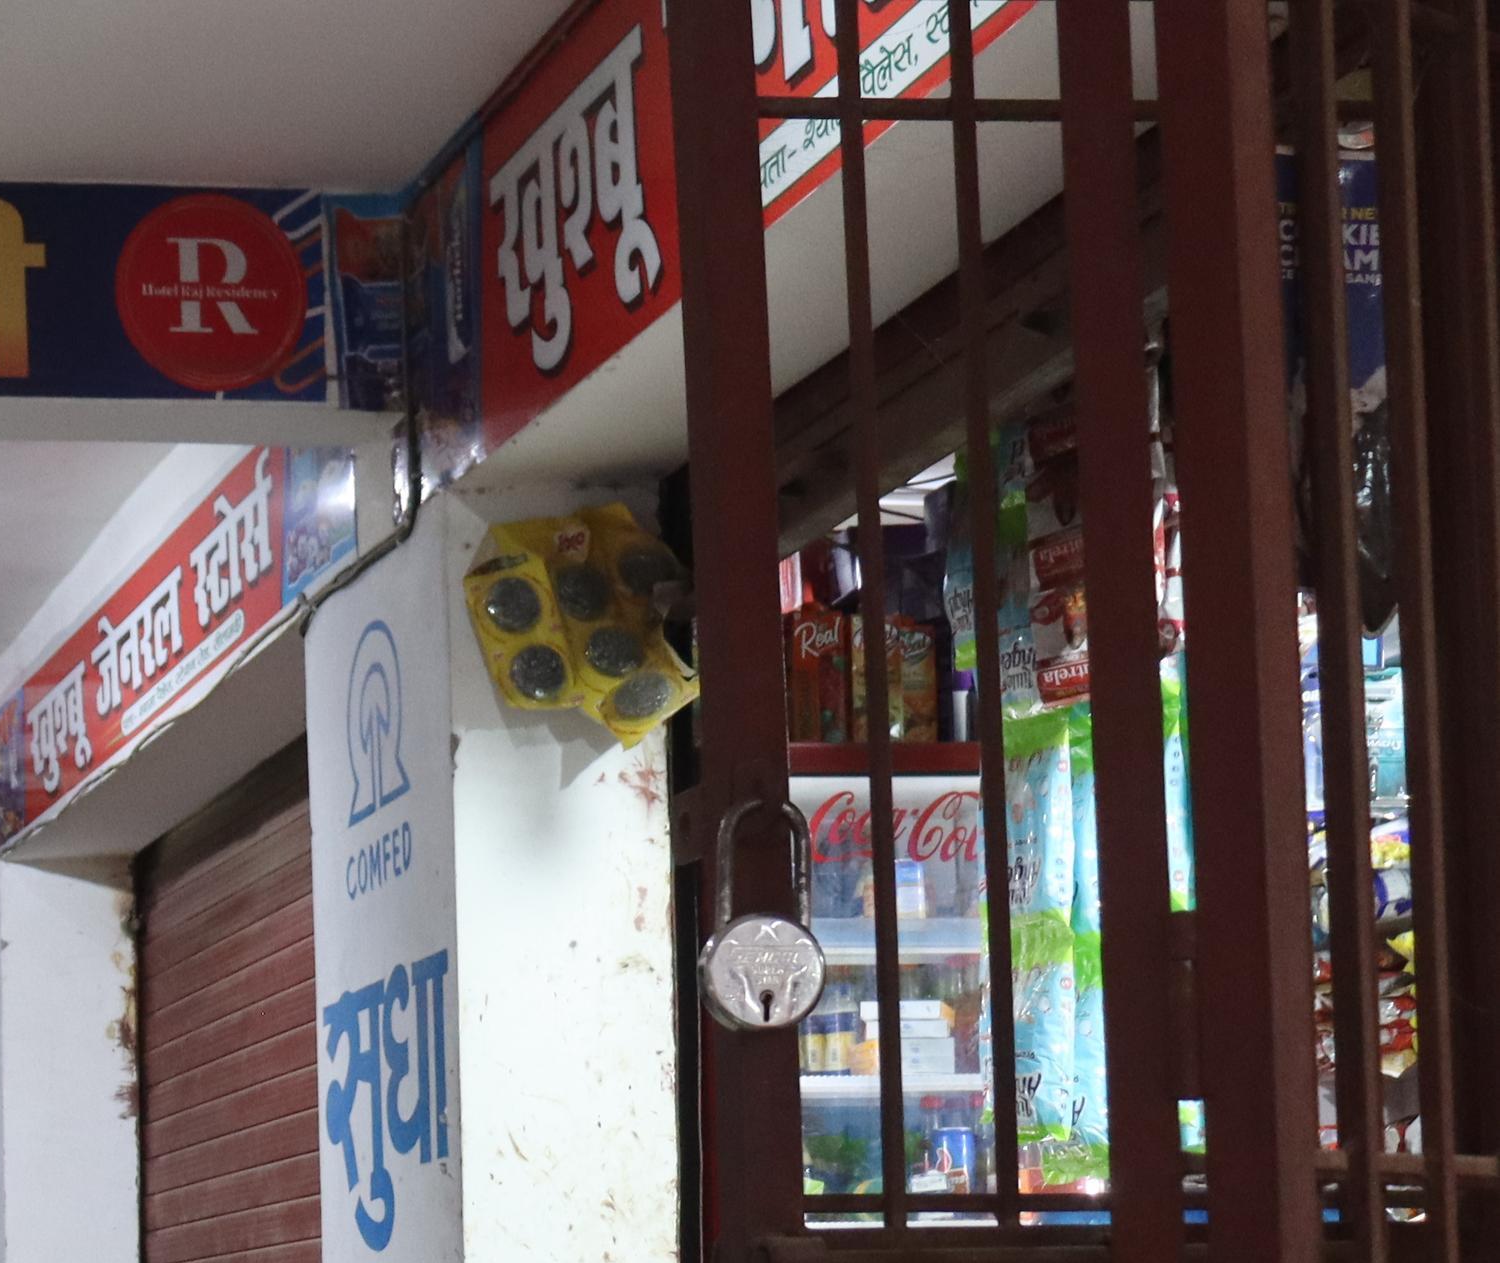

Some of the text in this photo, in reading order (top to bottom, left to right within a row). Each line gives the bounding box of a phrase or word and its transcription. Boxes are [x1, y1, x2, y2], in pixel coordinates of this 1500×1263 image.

[489, 24, 662, 372] खुशबू
[166, 237, 259, 335] R
[794, 617, 842, 659] Real
[26, 660, 92, 794] खुशबू
[345, 826, 413, 901] COMFED
[323, 947, 450, 1253] सुधा
